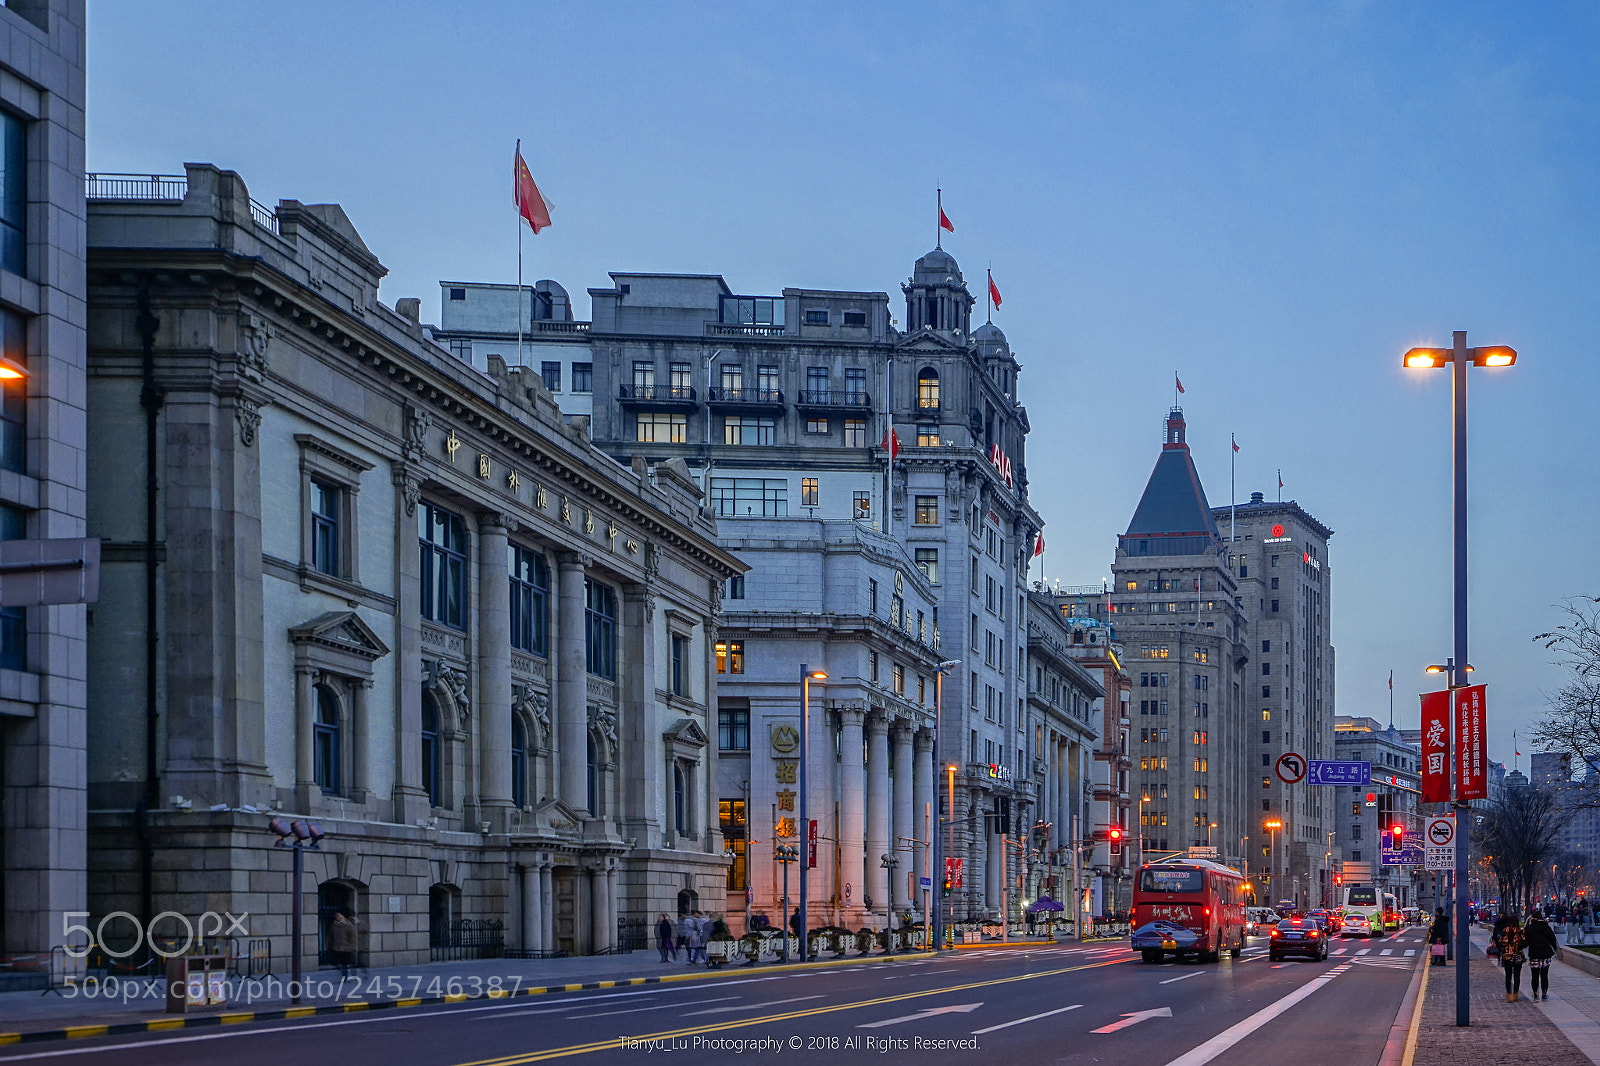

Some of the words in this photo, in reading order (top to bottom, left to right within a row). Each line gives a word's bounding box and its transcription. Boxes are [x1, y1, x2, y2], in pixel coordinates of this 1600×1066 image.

[990, 443, 1013, 489] AIA
[1326, 766, 1358, 774] 九江路
[1426, 719, 1446, 775] 爱国
